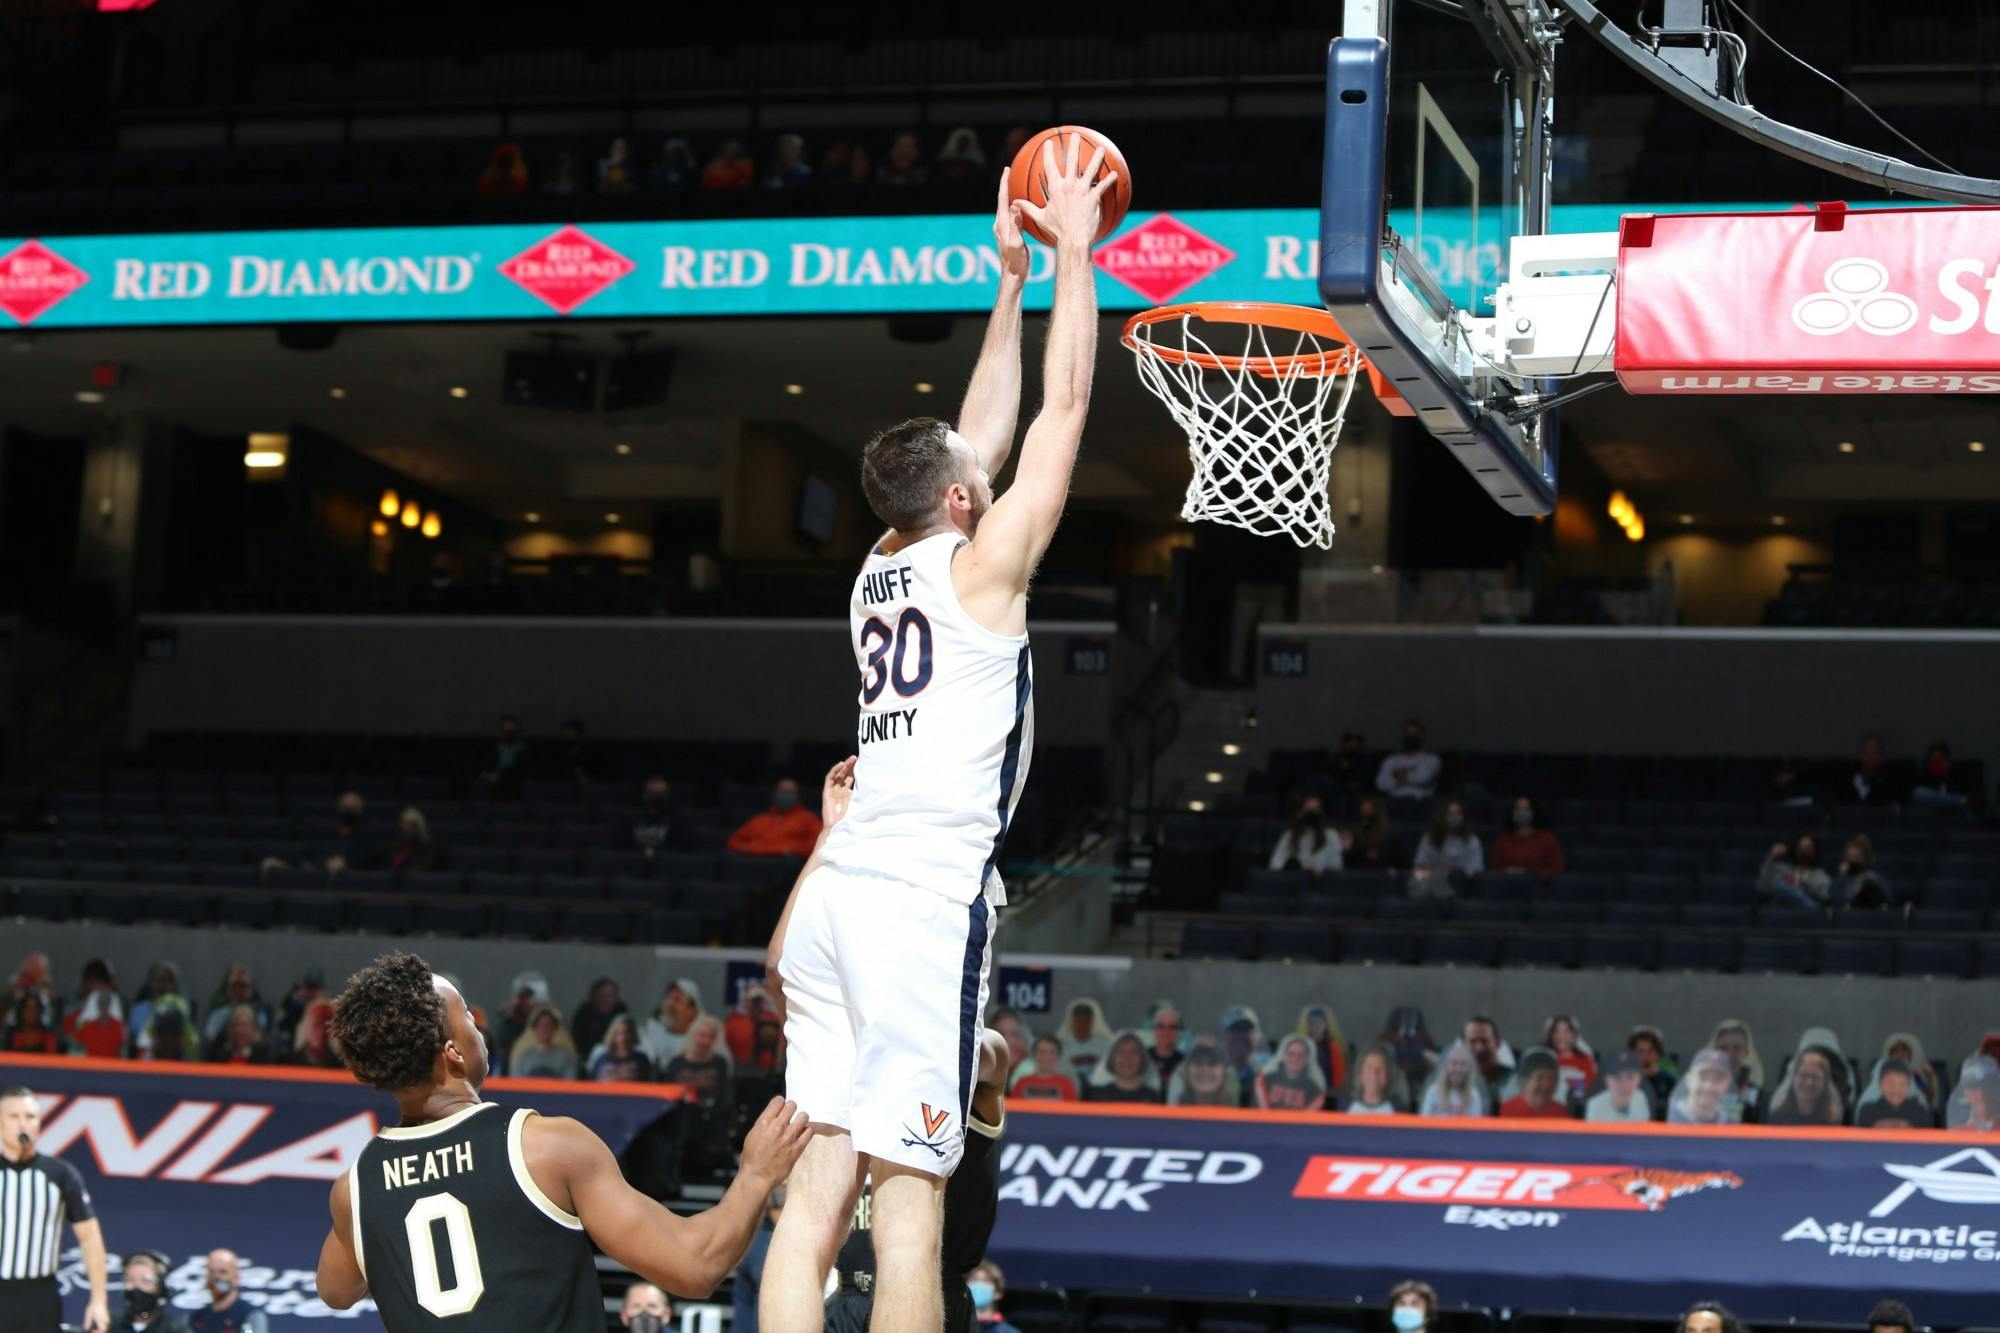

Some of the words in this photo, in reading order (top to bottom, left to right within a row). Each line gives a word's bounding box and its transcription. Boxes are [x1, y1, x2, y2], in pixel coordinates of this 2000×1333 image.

[1138, 232, 1187, 250] RED
[111, 257, 212, 300] RED
[226, 254, 475, 298] DIAMOND
[661, 246, 770, 288] RED
[1660, 375, 1826, 392] Farm
[862, 565, 912, 606] HUFF
[860, 606, 934, 706] 30
[861, 707, 918, 745] UNITY
[1005, 982, 1047, 1010] 104
[382, 1140, 474, 1190] NEATH
[1326, 1161, 1574, 1202] TIGER
[997, 1174, 1166, 1212] ANK
[1443, 1204, 1561, 1231] Exxon
[1780, 1215, 1999, 1248] Atlantic
[404, 1191, 485, 1319] 0
[1827, 1242, 1968, 1264] Mortgage
